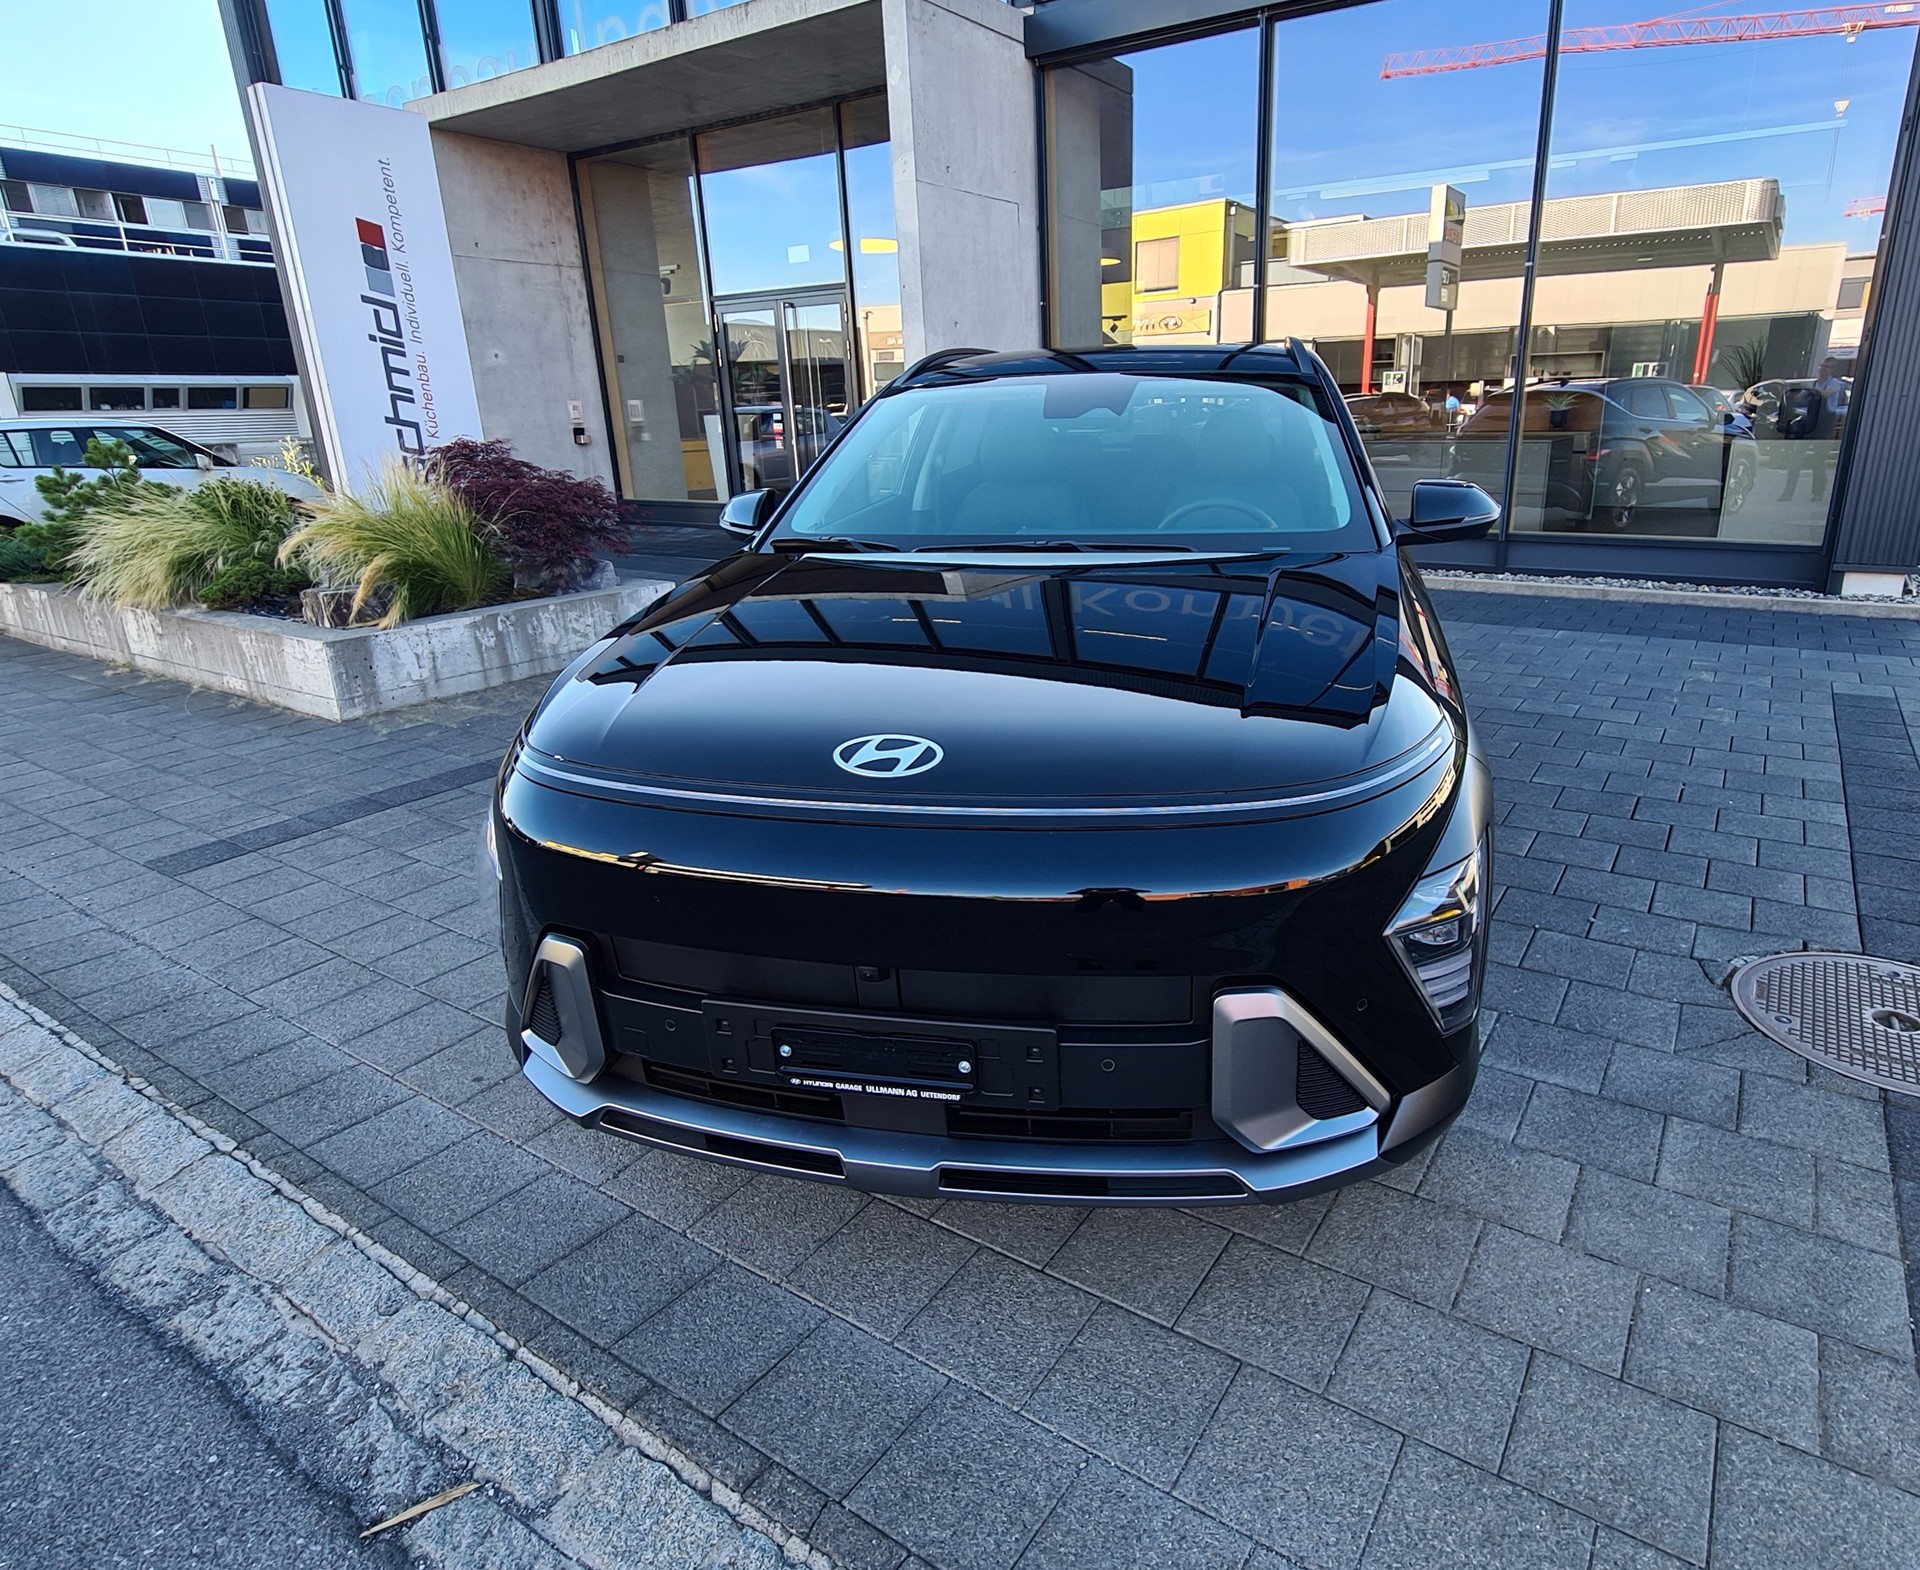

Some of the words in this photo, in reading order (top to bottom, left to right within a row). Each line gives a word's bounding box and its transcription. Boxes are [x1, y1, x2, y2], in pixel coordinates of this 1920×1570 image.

[378, 157, 406, 253] Kompetent.
[395, 260, 423, 344] Individuell.
[360, 294, 426, 471] chmid
[416, 351, 440, 439] Küchenbau.
[802, 1079, 834, 1088] HYUNDAI
[835, 1082, 863, 1092] GARAGE
[865, 1084, 905, 1096] ULLMANN
[905, 1088, 918, 1098] AG
[920, 1090, 961, 1101] UETENDORF
